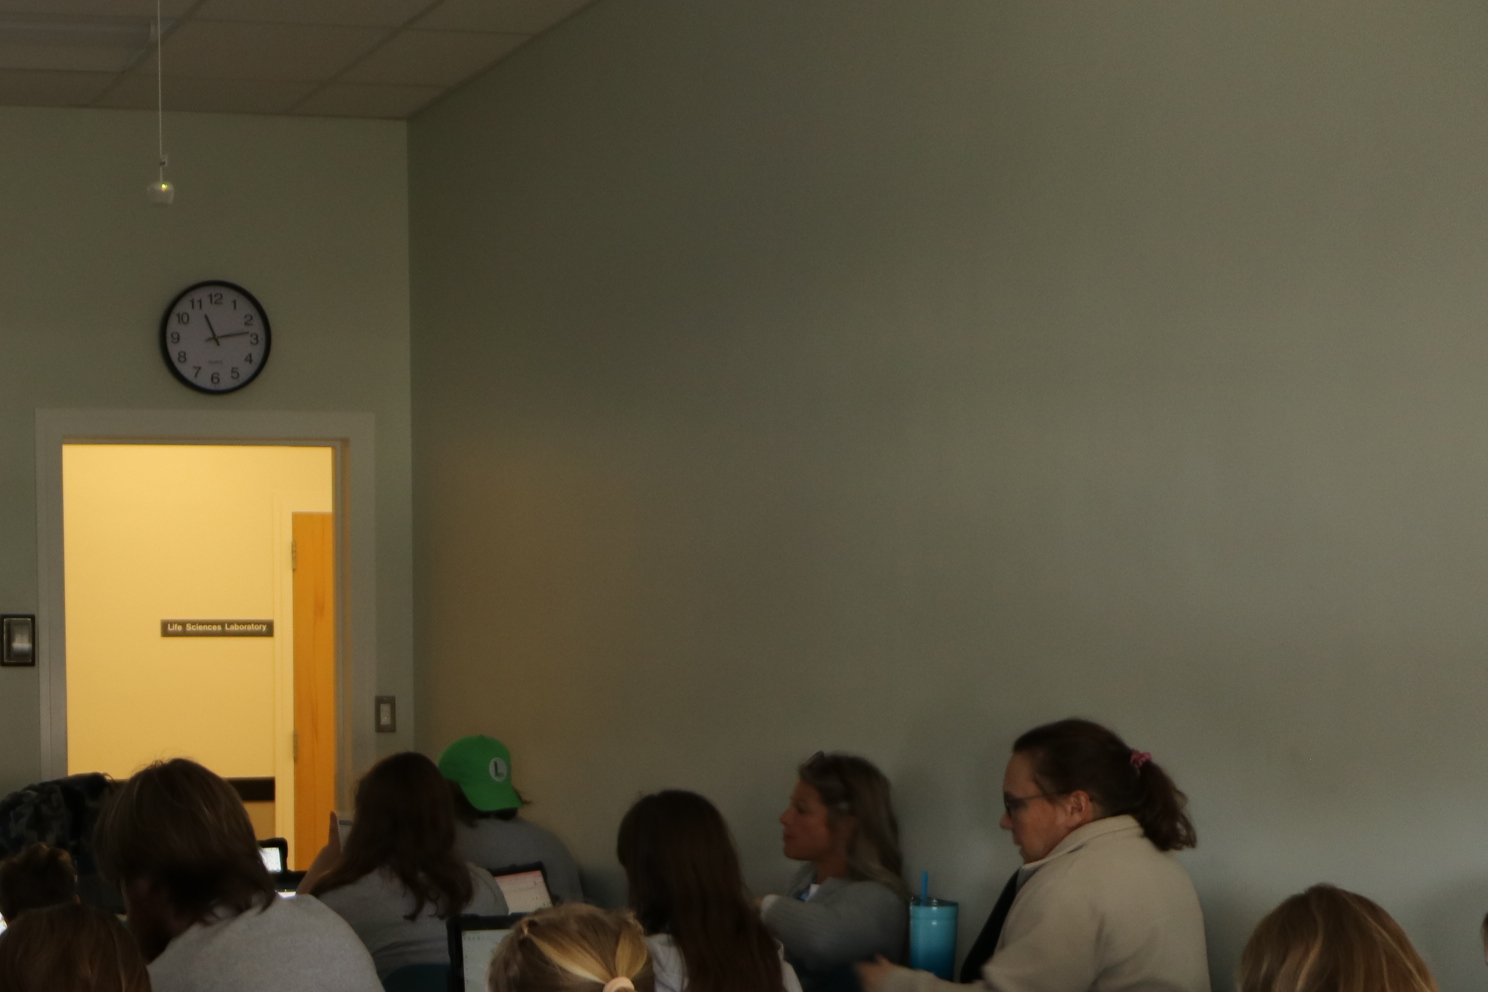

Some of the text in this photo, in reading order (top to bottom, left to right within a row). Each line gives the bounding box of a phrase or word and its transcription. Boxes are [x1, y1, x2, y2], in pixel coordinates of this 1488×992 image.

[190, 298, 202, 310] 11
[208, 292, 223, 305] 12
[232, 299, 237, 310] 1
[176, 312, 190, 325] 10
[243, 314, 254, 326] 2
[170, 331, 180, 344] 9
[249, 332, 259, 345] 3
[177, 351, 187, 364] 8
[244, 352, 254, 365] 4
[193, 366, 202, 378] 7
[210, 372, 220, 385] 6
[230, 366, 240, 379] 5
[167, 622, 267, 632] Life Sciences Laboratory
[494, 760, 505, 777] L
